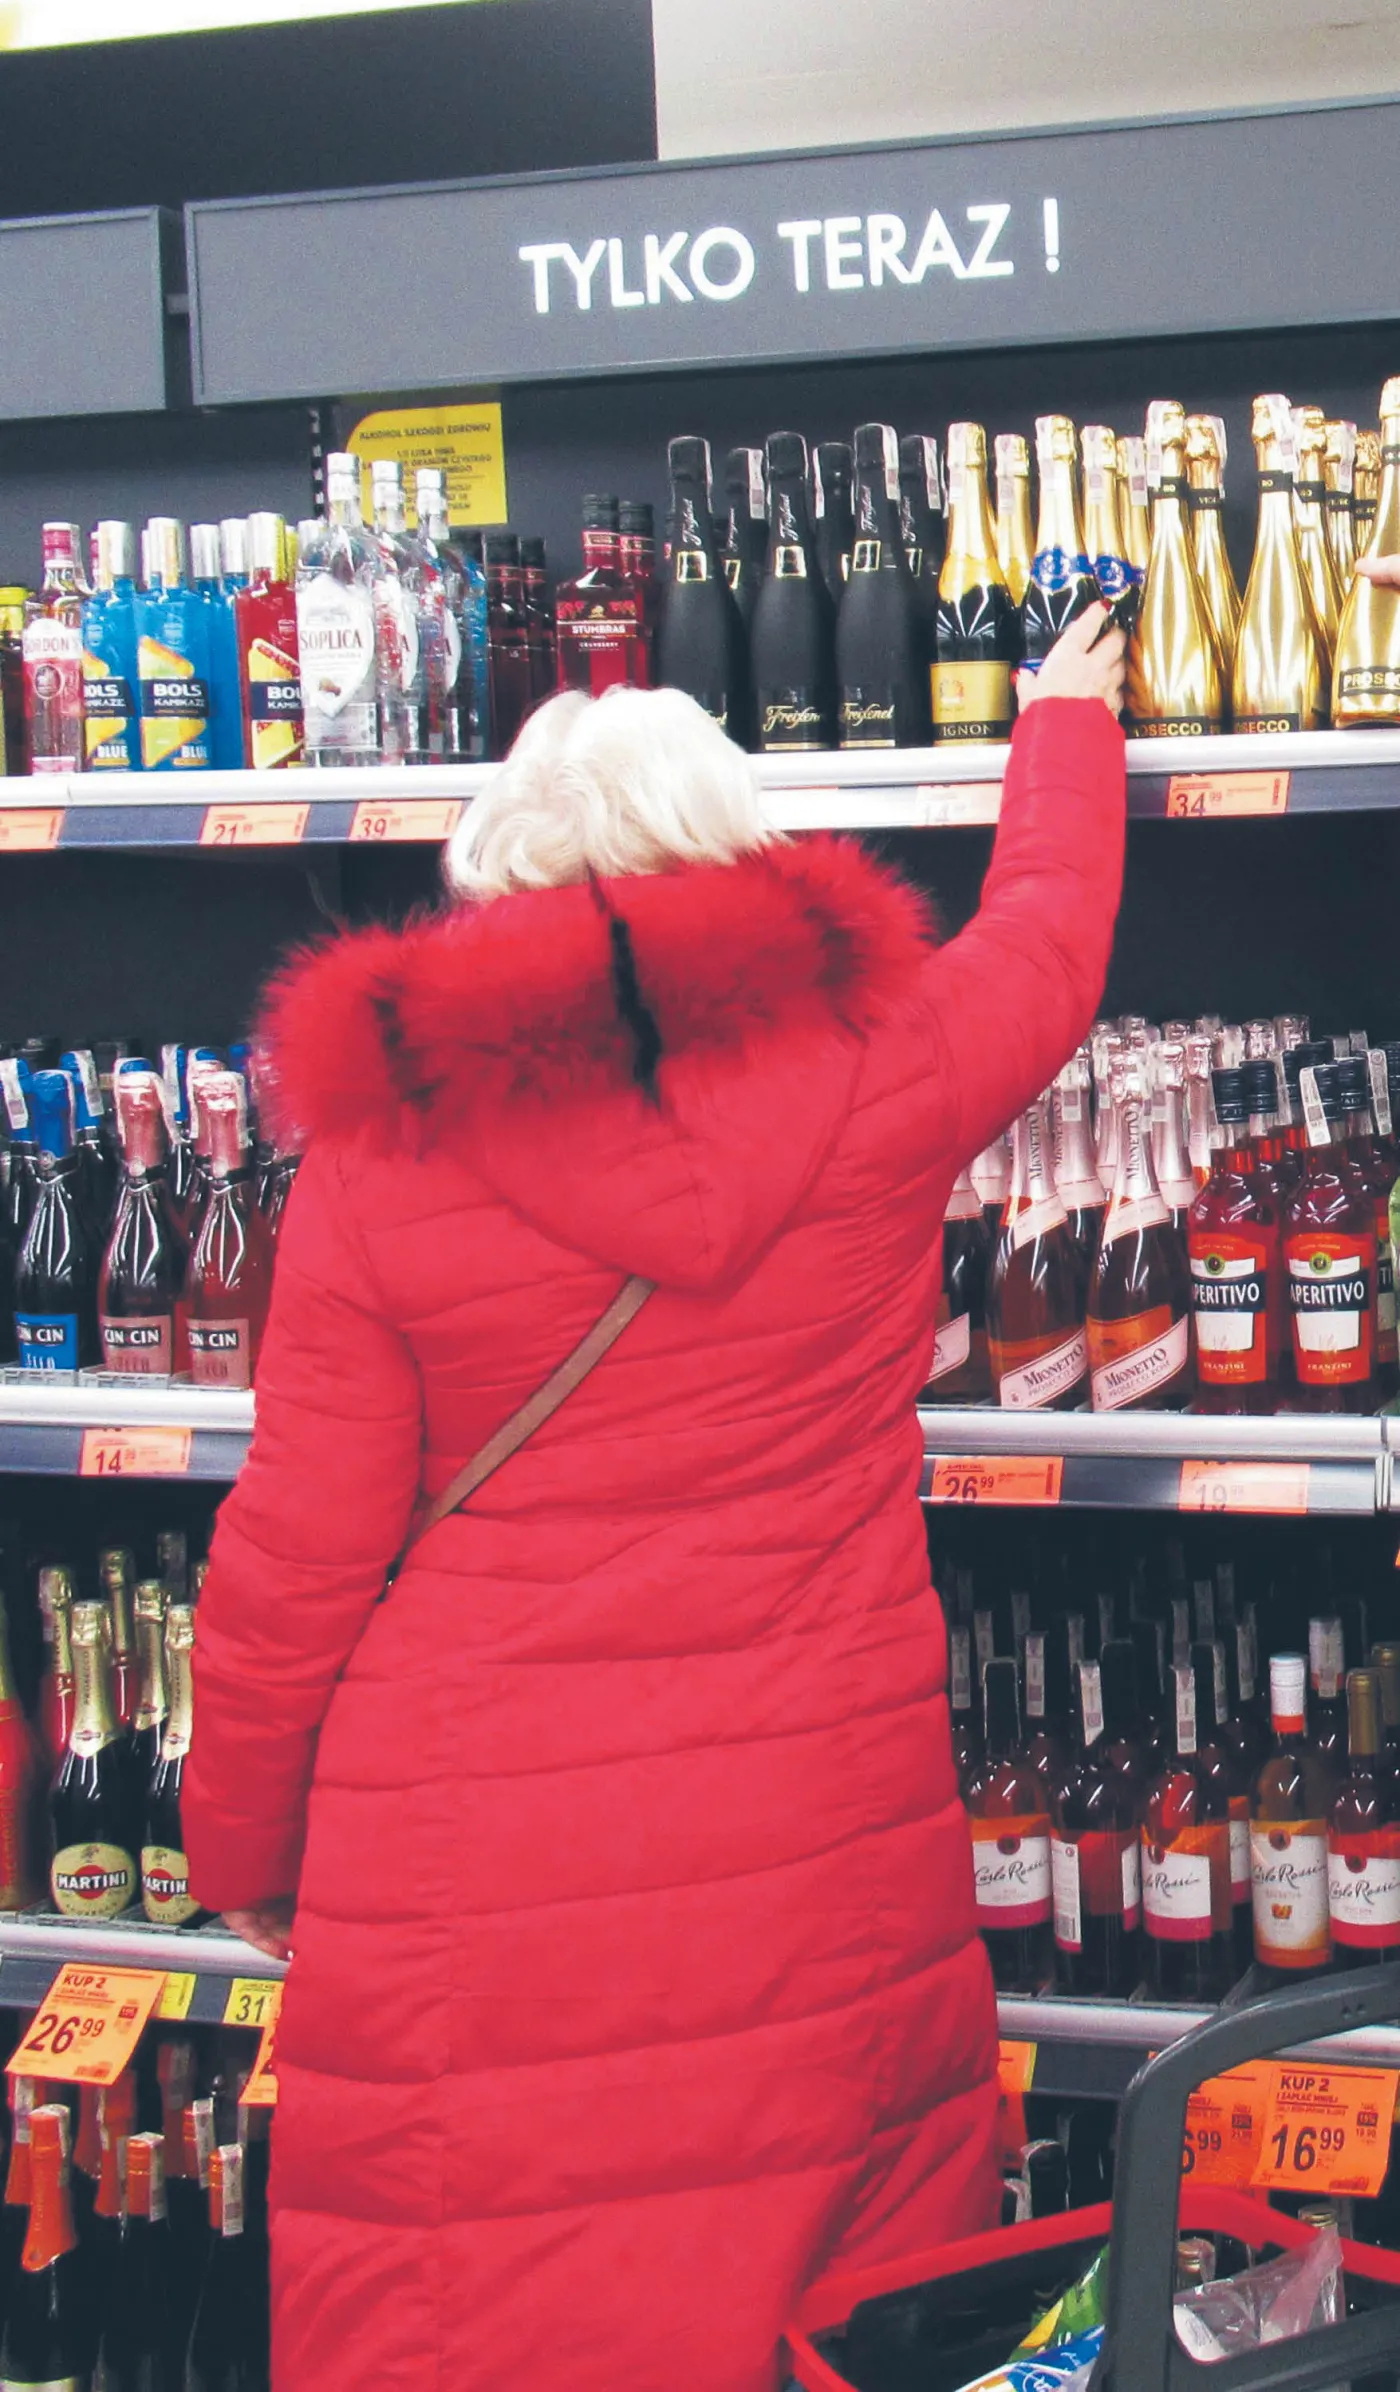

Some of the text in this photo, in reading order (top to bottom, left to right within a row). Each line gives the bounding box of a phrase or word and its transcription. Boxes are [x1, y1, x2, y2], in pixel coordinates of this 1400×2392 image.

[519, 198, 1060, 313] TYLKO TERAZ !
[300, 629, 363, 651] SOPLICA
[153, 683, 202, 697] BOLS
[97, 745, 128, 758] BLUE
[1174, 792, 1206, 816] 34
[213, 823, 238, 845] 21
[361, 817, 387, 840] 39
[1194, 1282, 1260, 1304] PERITIVO
[37, 1327, 64, 1343] CIN
[130, 1329, 159, 1345] CIN
[208, 1332, 237, 1348] CIN
[1023, 1342, 1084, 1390] MIONETTO
[1104, 1347, 1167, 1390] MIONETTO
[95, 1449, 122, 1473] 14
[943, 1475, 978, 1503] 26
[980, 1476, 995, 1488] 99
[58, 1872, 127, 1889] MARTINI
[61, 1974, 107, 1989] KUP 2
[235, 1994, 266, 2023] 31
[24, 2013, 105, 2054] 26 99
[1280, 2074, 1330, 2093] KUP 2
[1197, 2129, 1222, 2151] 99
[1271, 2123, 1317, 2172] 16
[1320, 2126, 1345, 2151] 99
